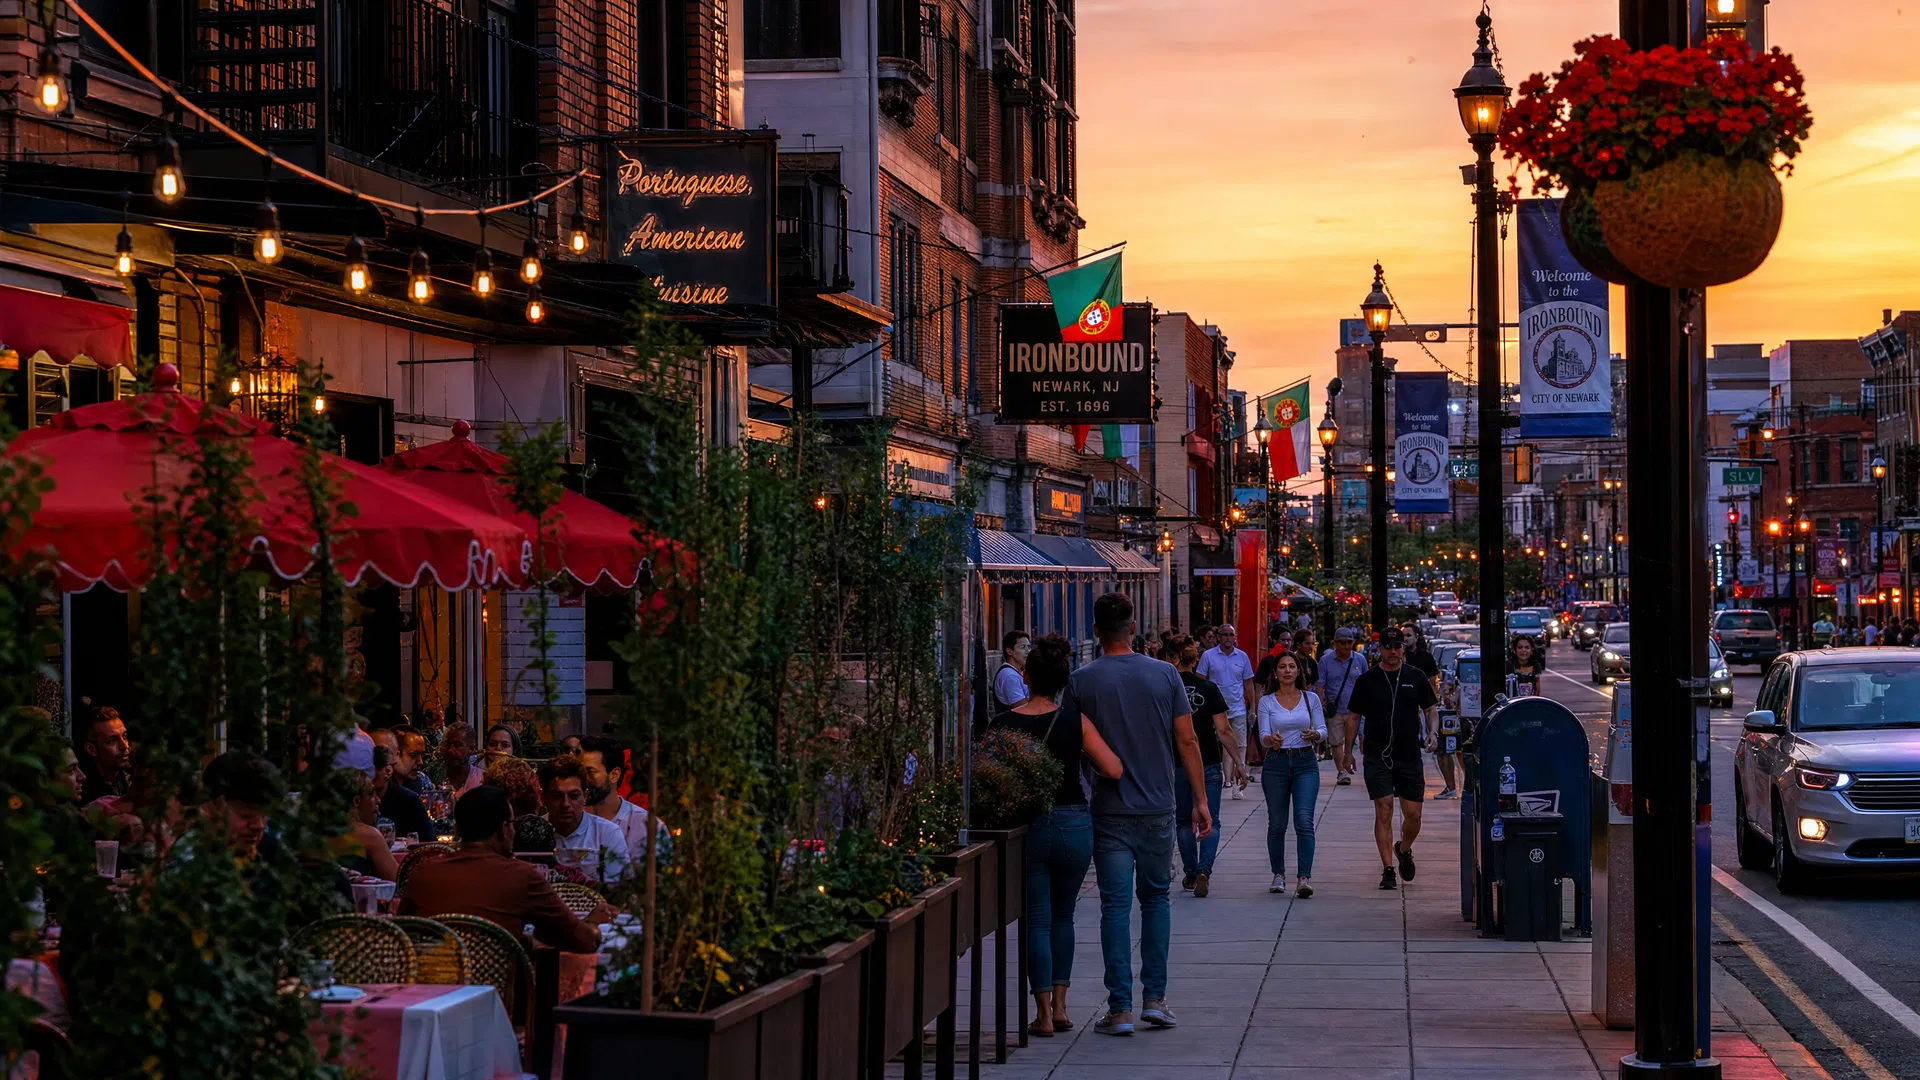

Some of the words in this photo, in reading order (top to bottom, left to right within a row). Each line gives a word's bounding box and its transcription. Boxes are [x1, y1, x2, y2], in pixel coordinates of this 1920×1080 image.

[618, 154, 753, 207] Portuguese,
[621, 213, 746, 257] American
[1531, 269, 1592, 282] Welcome
[653, 275, 730, 305] uisine
[1548, 286, 1559, 297] to
[1563, 285, 1579, 296] the
[1526, 306, 1602, 340] IRONBOUND
[1009, 342, 1145, 373] IRONBOUND
[1032, 380, 1096, 394] NEWARK,
[1103, 381, 1120, 393] NJ
[1531, 394, 1550, 404] CITY
[1552, 394, 1563, 403] OF
[1565, 393, 1600, 403] NEWARK
[1040, 400, 1070, 412] EST.
[1076, 400, 1111, 412] 1696
[1403, 412, 1439, 422] Welcome
[1412, 423, 1419, 431] to
[1420, 422, 1431, 431] the
[1399, 435, 1445, 456] IRONBOUND
[1729, 471, 1755, 482] SLV
